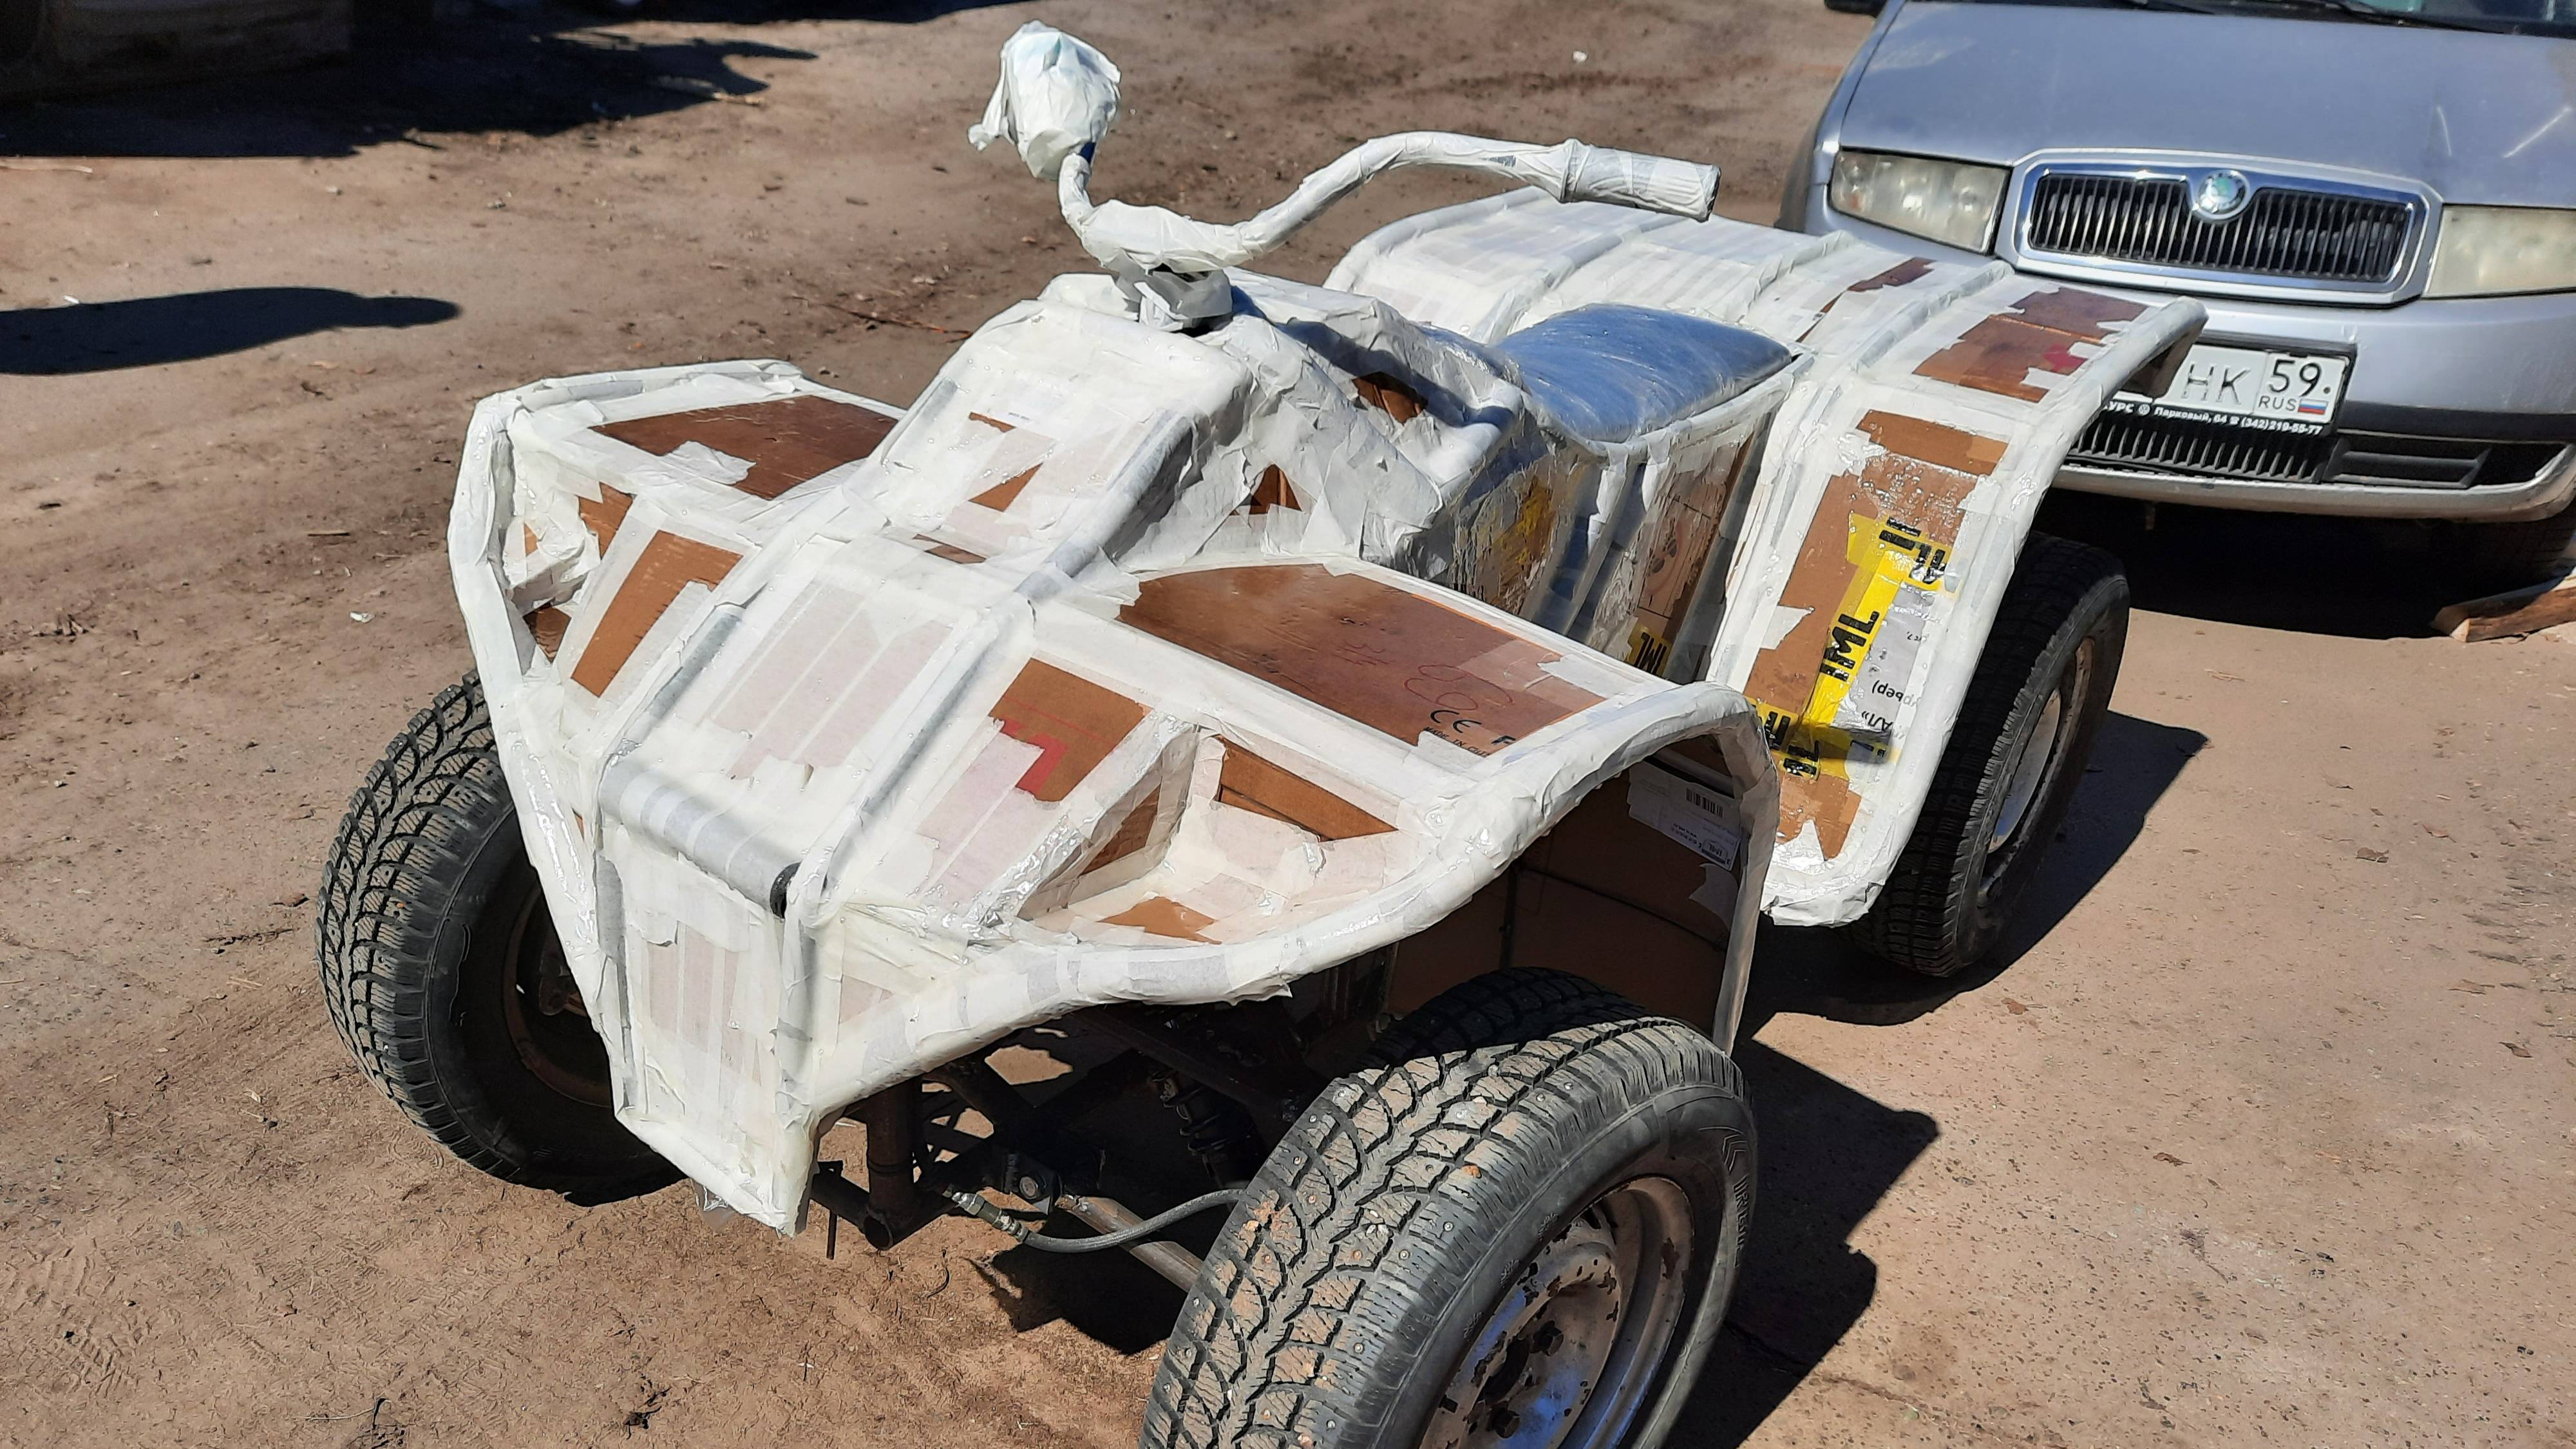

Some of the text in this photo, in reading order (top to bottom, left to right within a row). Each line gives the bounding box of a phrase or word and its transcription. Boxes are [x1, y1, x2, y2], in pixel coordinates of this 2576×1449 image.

[2181, 359, 2320, 405] HK 59
[2259, 395, 2297, 412] RUS
[1819, 611, 1880, 681] IML
[1430, 710, 1482, 734] CE
[1862, 710, 1895, 733] АЛ»
